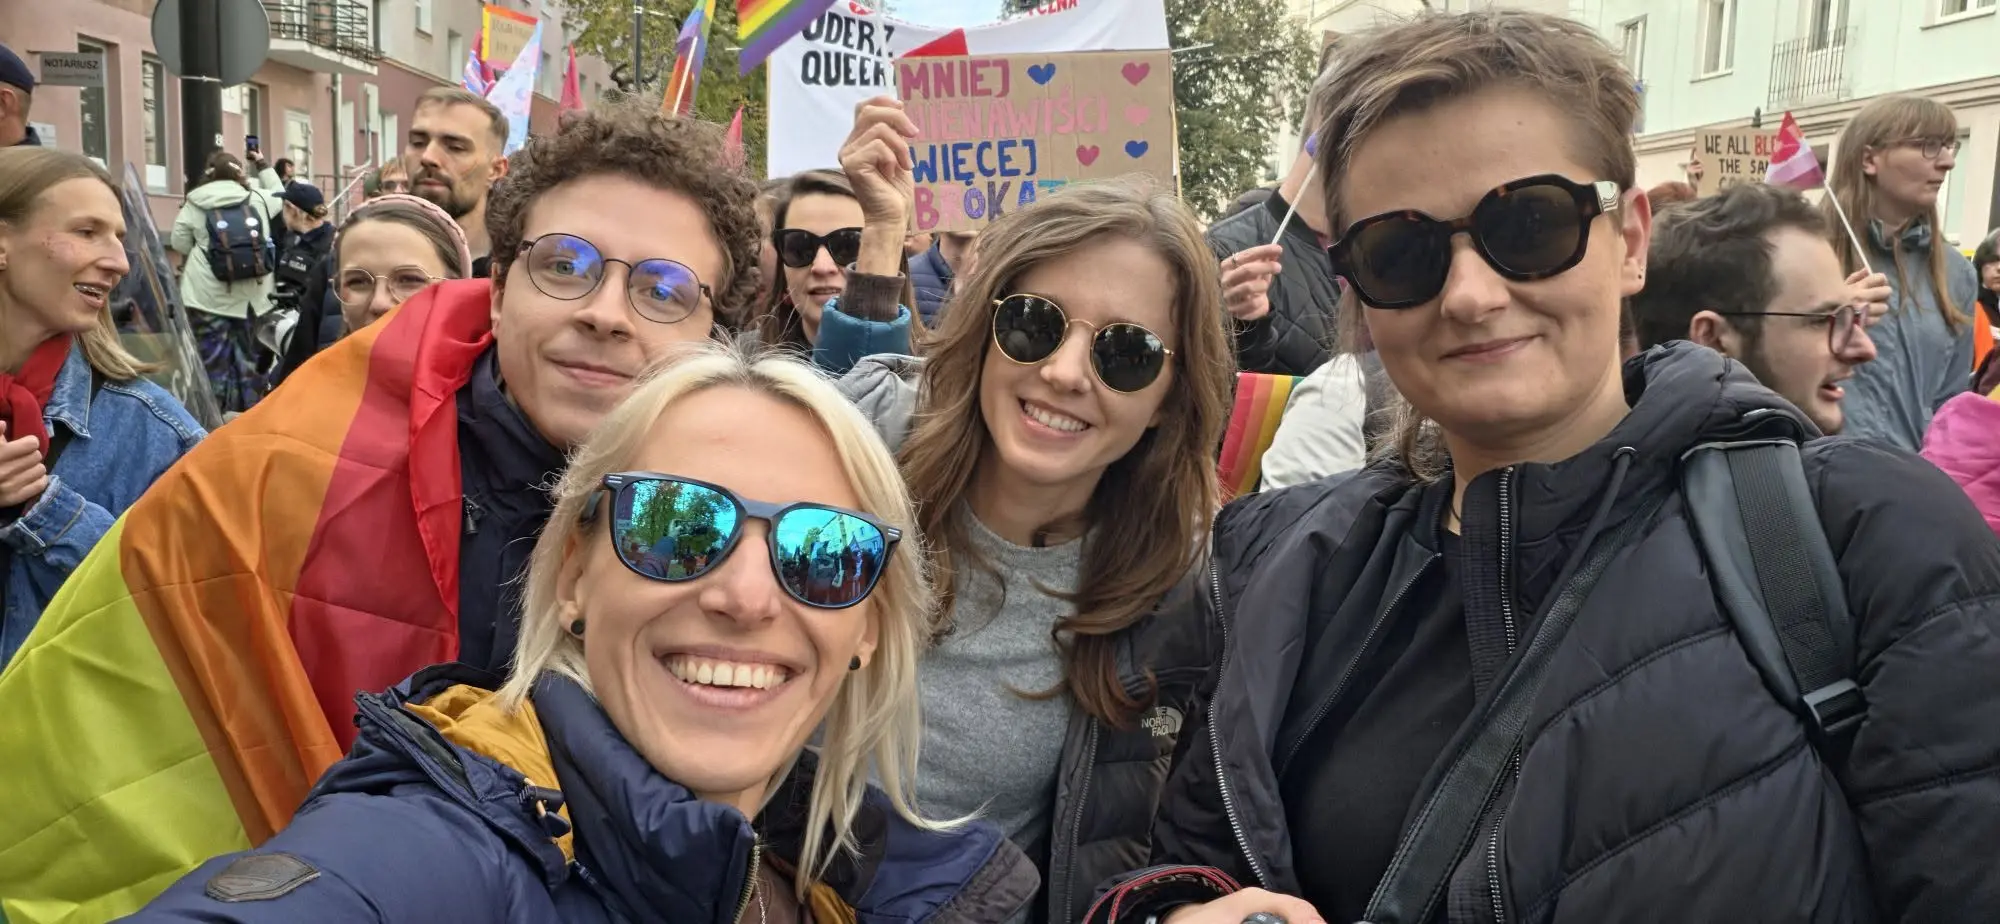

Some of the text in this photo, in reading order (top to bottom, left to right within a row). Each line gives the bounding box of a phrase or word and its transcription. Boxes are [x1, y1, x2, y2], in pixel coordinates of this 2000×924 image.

[44, 58, 99, 69] NOTARIUSZ
[801, 50, 896, 86] QUEER
[900, 58, 1010, 101] MNIEJ
[1705, 135, 1722, 154] WE
[1727, 135, 1750, 154] ALL
[910, 139, 1037, 186] WIĘCEJ
[1719, 158, 1741, 174] THE
